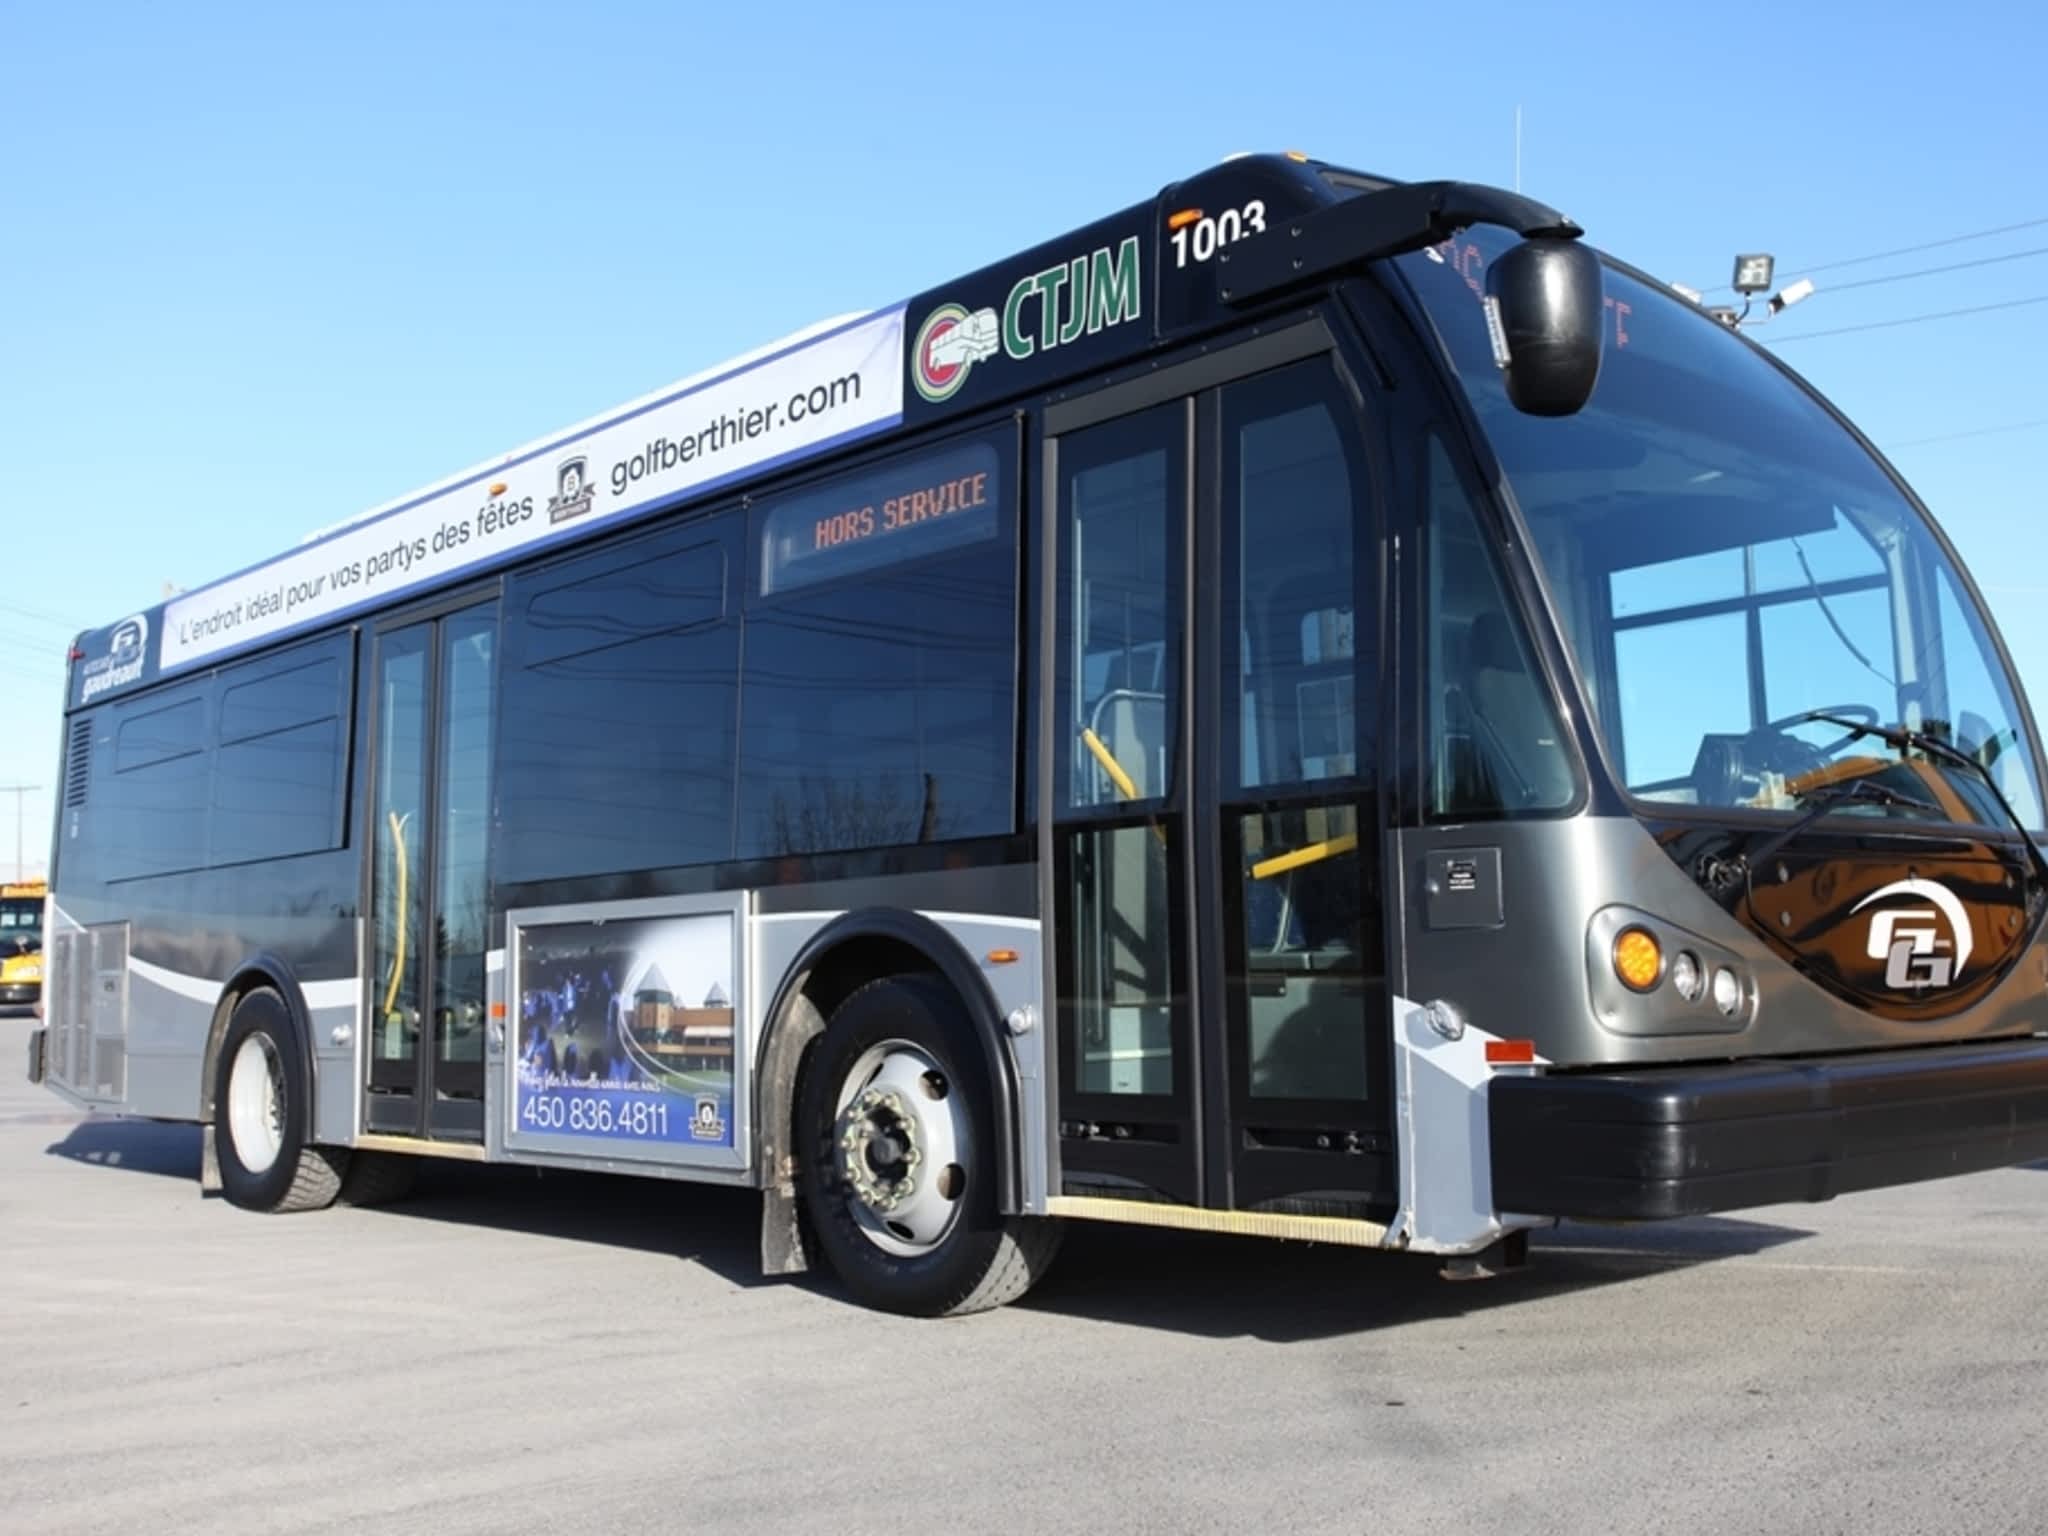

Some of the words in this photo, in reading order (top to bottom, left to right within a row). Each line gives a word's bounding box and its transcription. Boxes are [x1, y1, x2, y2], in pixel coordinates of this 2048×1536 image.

[1170, 199, 1266, 268] 1003
[1002, 235, 1140, 360] CTJM
[610, 371, 862, 496] golfberthier.com
[814, 506, 875, 550] HORS
[882, 472, 987, 531] SERVICE
[179, 602, 243, 645] L'endroit
[245, 586, 284, 621] idéal
[286, 574, 326, 613] pour
[330, 562, 361, 591] vos
[365, 537, 427, 584] partys
[432, 522, 470, 554] des
[477, 495, 534, 537] fêtes
[523, 1095, 565, 1128] 450
[569, 1097, 668, 1136] 836.4811
